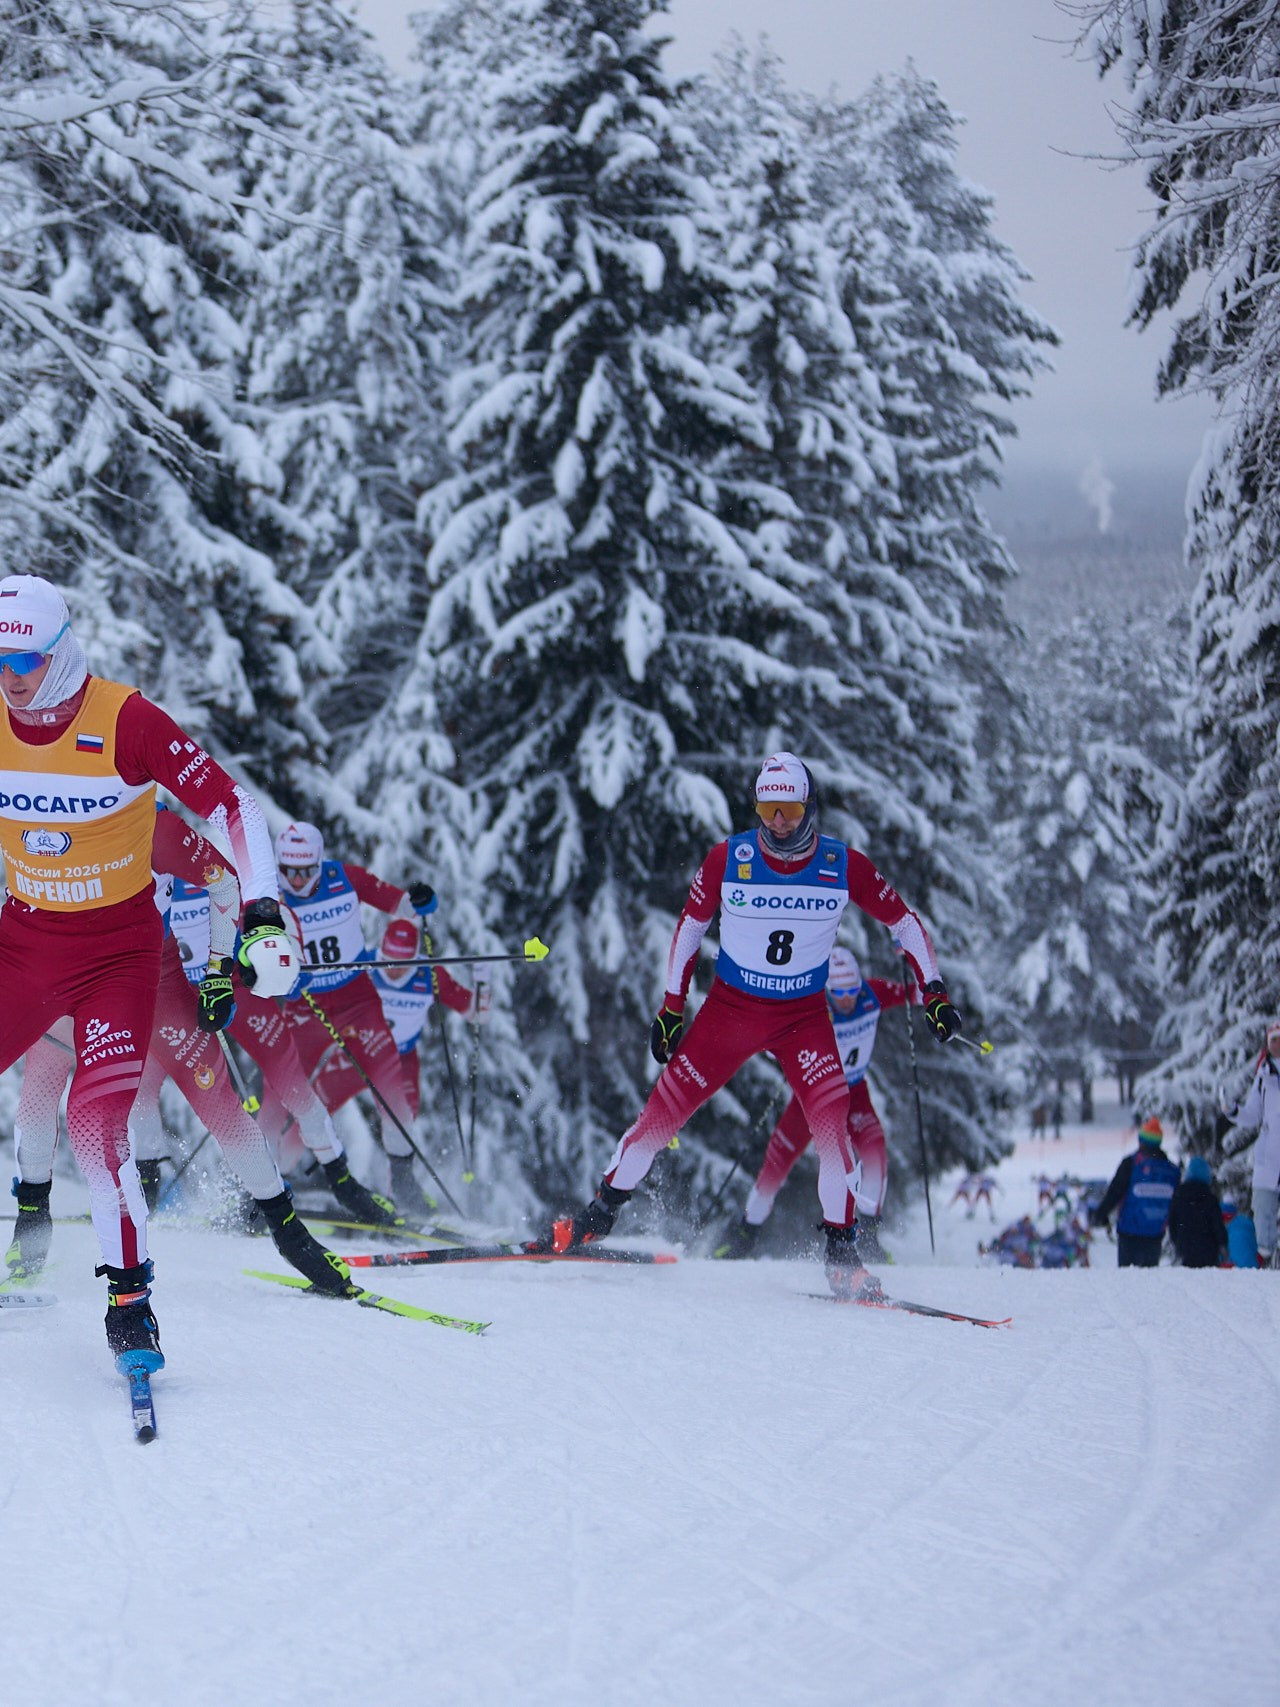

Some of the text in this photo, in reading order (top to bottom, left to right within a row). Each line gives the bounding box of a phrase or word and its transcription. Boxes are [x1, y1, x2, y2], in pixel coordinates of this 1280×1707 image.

[18, 860, 61, 878] России
[64, 863, 101, 878] 2026
[104, 853, 134, 871] года
[15, 871, 103, 903] ПЕРЕКОП
[173, 906, 210, 921] АГРО
[751, 896, 838, 911] ФОСАГРО
[304, 935, 341, 965] 18
[765, 929, 795, 966] 8
[740, 969, 813, 993] ЧЕПЕЦКОЕ
[84, 1044, 135, 1066] BIVIUM
